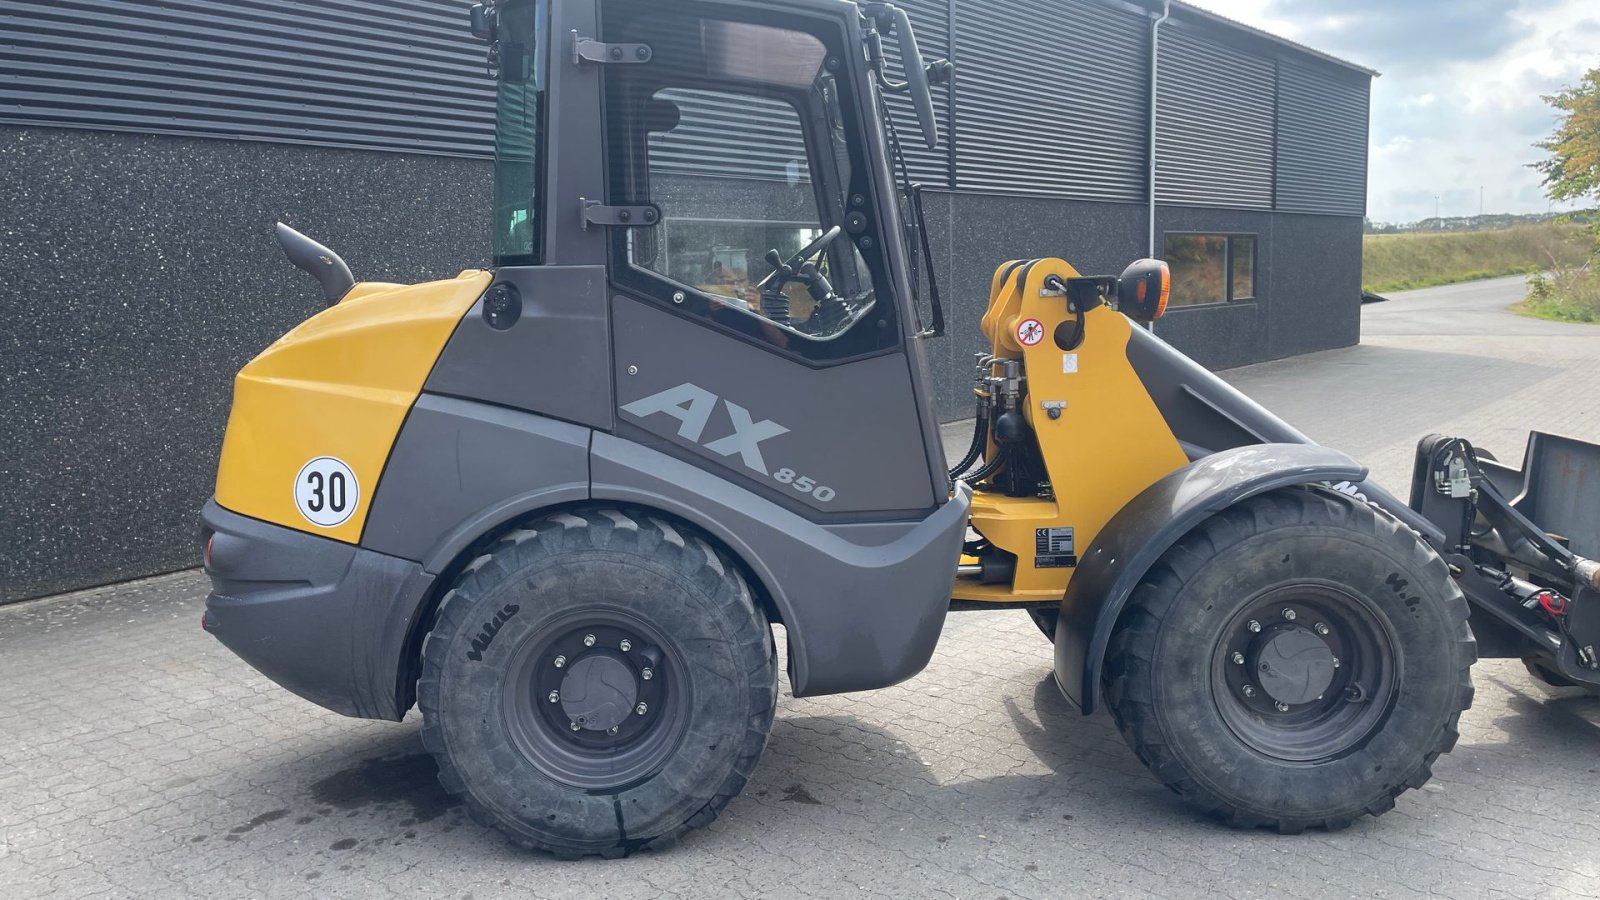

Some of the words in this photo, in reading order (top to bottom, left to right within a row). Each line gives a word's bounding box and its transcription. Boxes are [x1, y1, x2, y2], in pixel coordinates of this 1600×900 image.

[619, 382, 791, 477] AX
[773, 467, 836, 502] 850
[307, 471, 346, 512] 30
